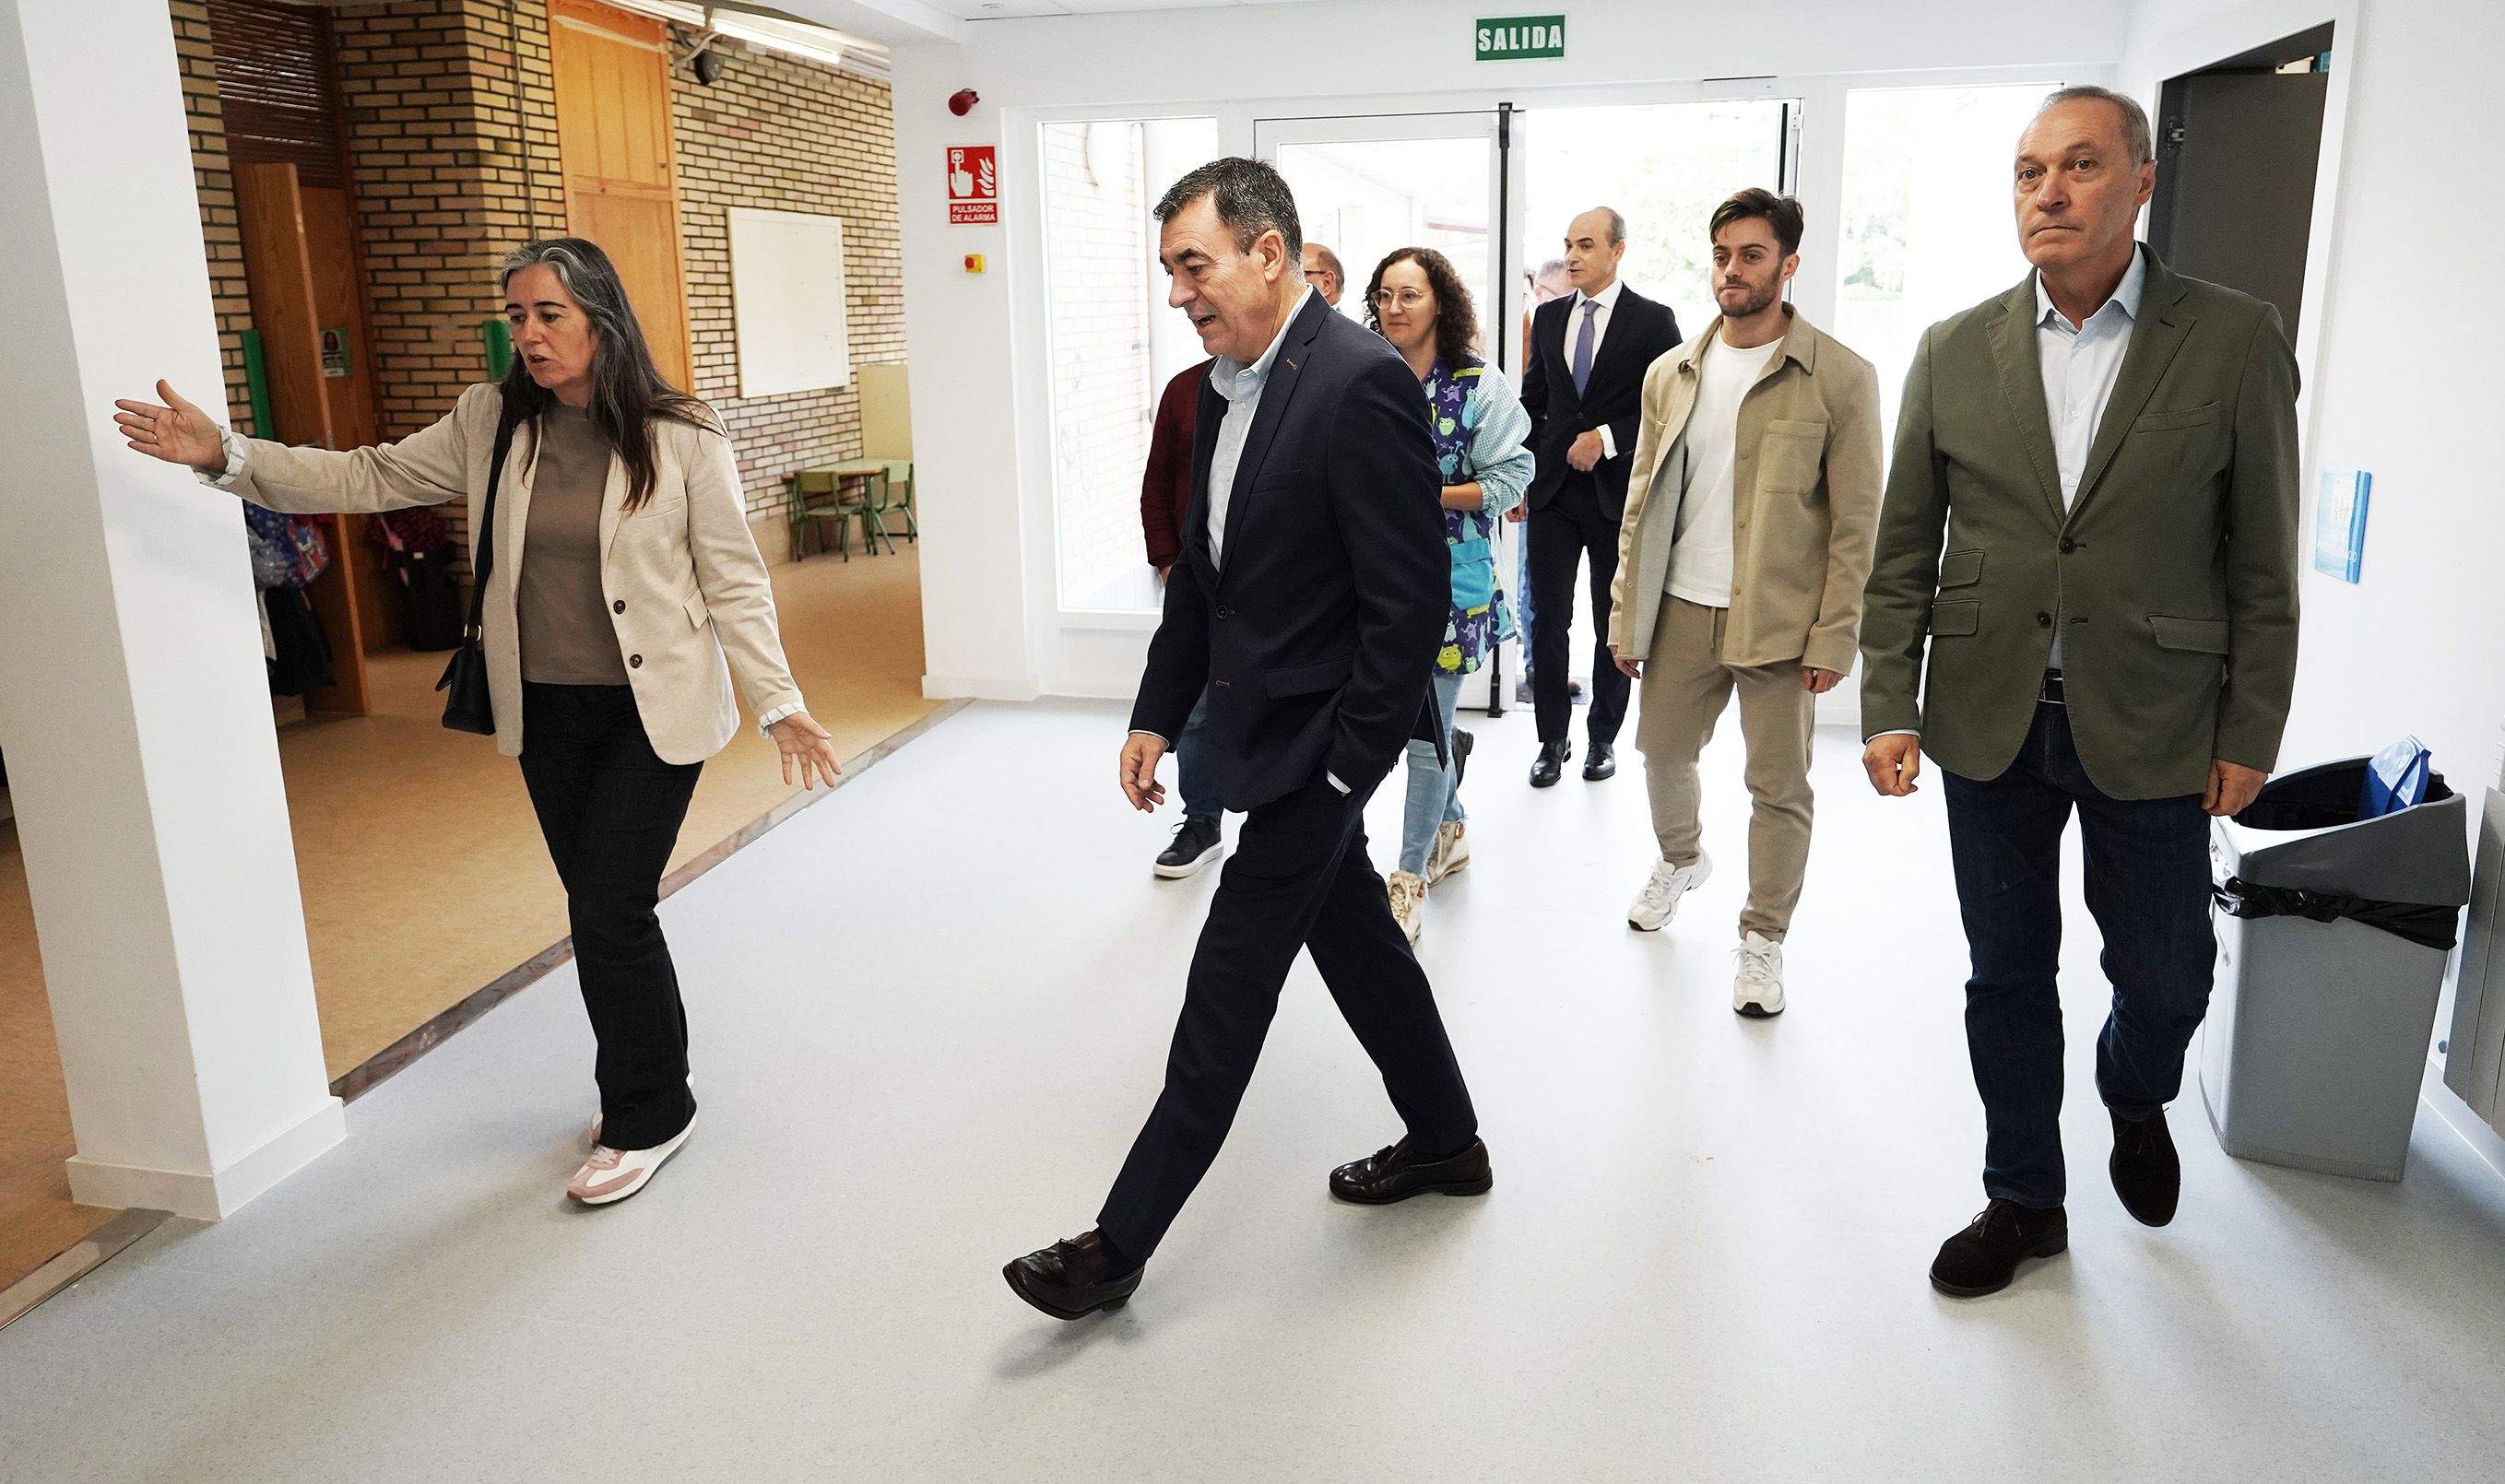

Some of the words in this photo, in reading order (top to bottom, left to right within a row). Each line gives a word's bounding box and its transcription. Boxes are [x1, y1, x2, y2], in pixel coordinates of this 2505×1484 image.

[1478, 25, 1563, 52] SALIDA
[952, 205, 994, 213] PULSADOR
[951, 214, 963, 222] DE
[963, 214, 996, 222] ALARMA
